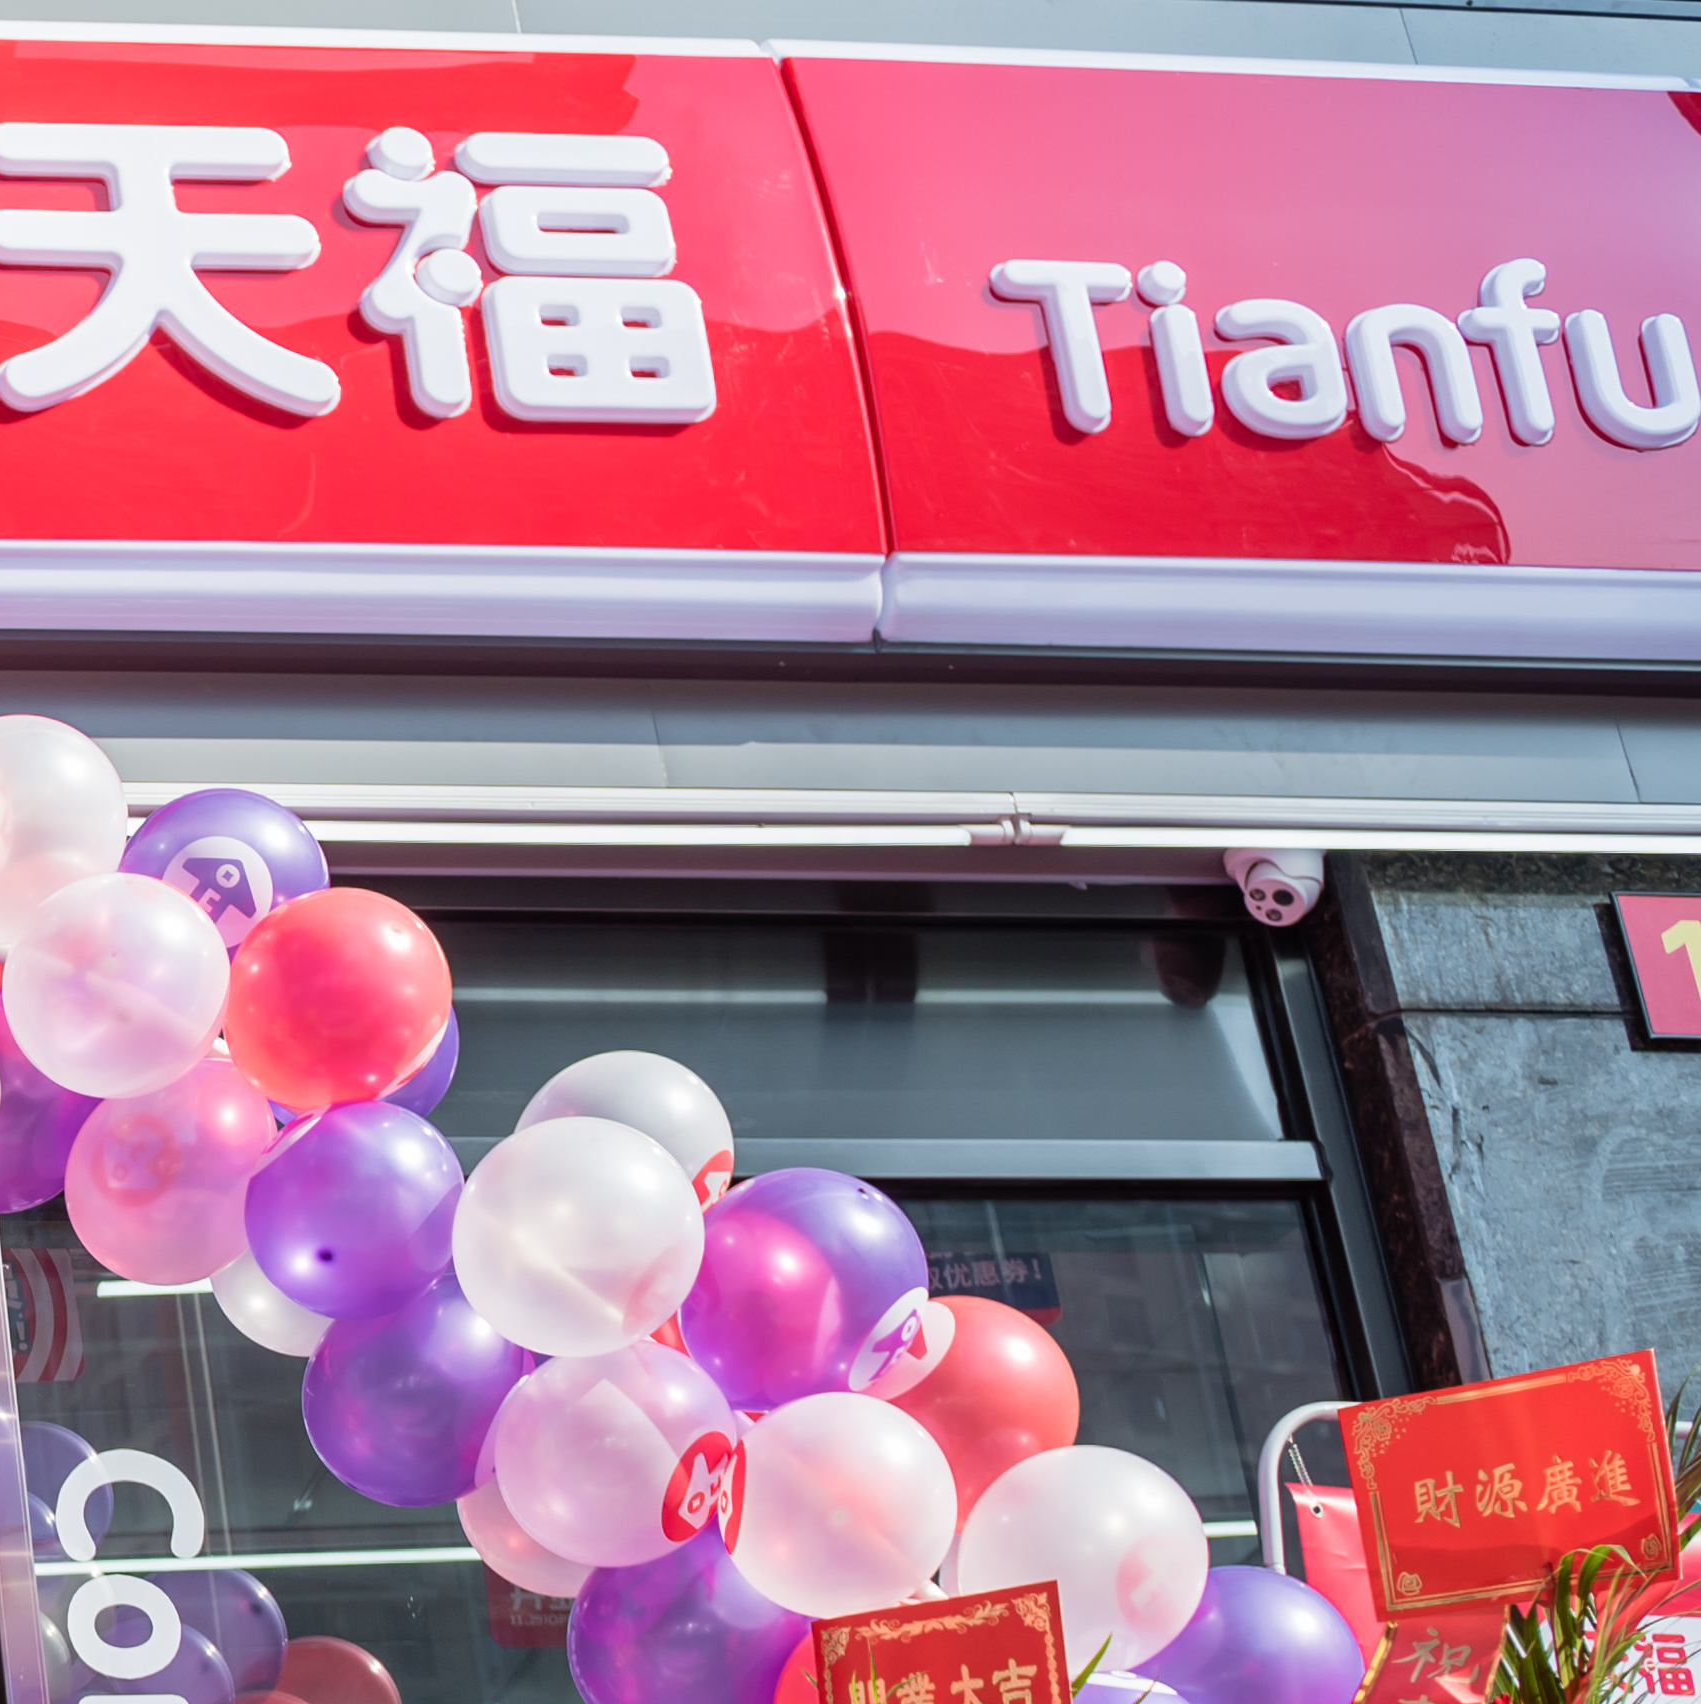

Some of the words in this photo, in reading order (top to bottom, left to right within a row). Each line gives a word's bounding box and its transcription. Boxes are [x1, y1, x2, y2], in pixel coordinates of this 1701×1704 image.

[989, 258, 1701, 450] Tianfu
[1412, 1448, 1643, 1529] 財源廣進
